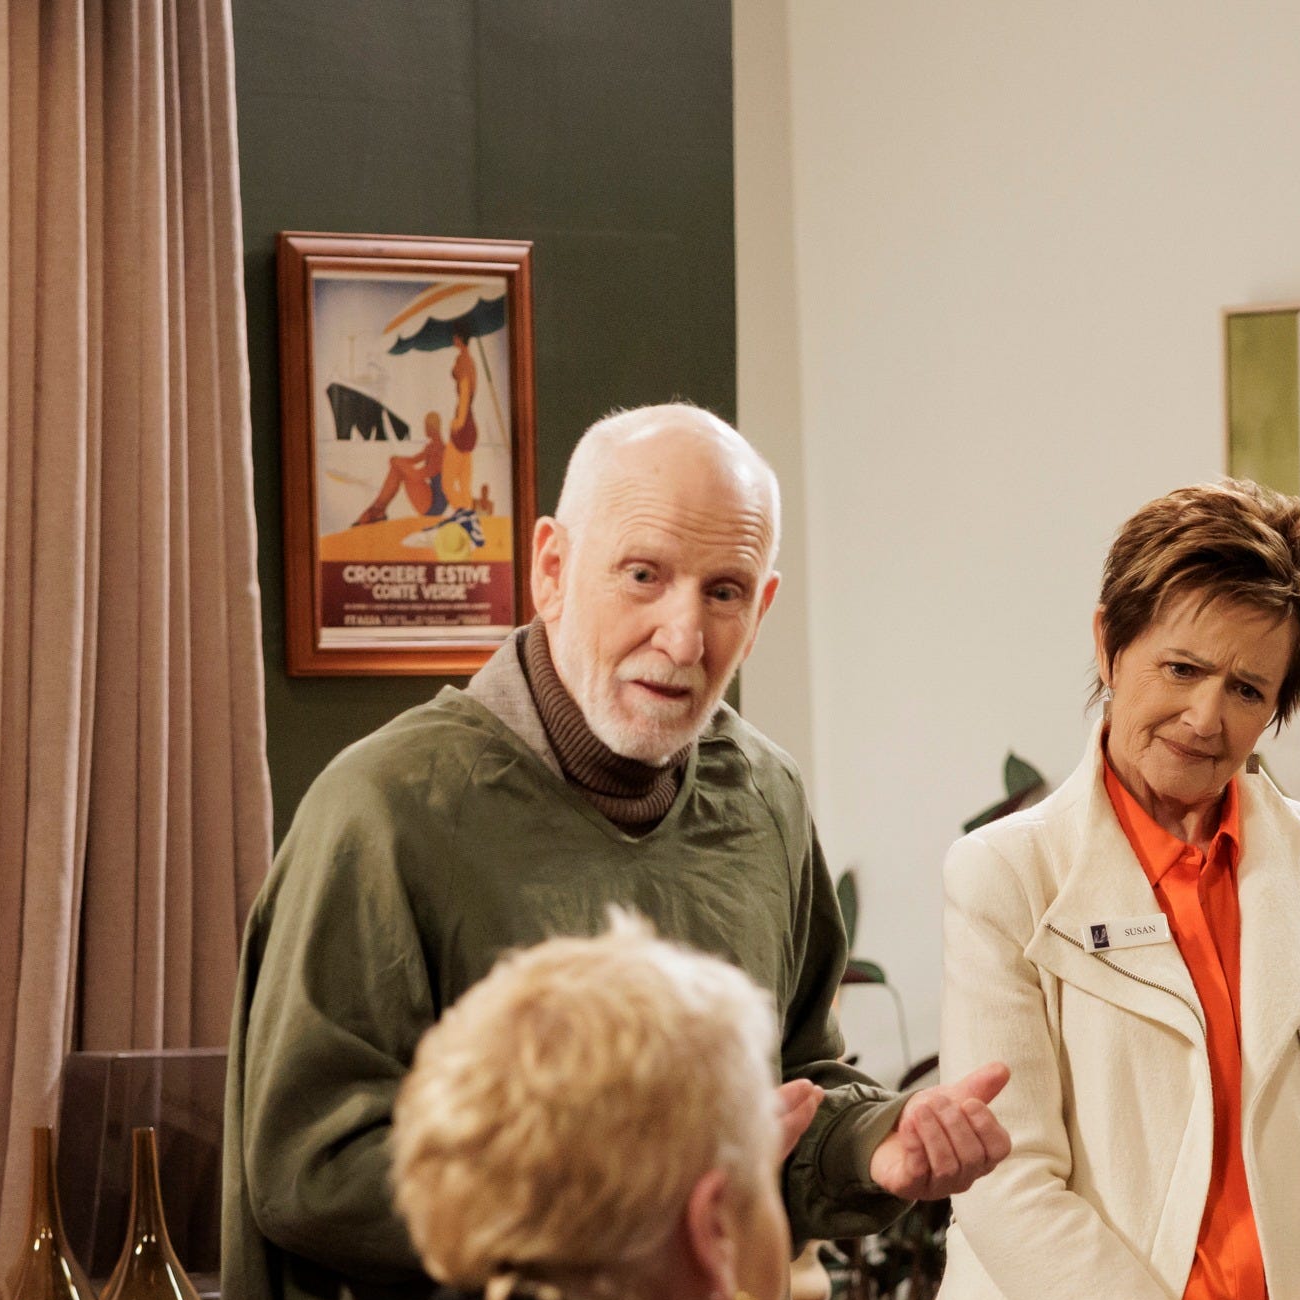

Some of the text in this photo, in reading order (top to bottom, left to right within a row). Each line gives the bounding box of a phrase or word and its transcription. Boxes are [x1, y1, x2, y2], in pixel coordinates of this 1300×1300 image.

[343, 565, 491, 584] CROCIERE ESTIVE
[372, 584, 418, 600] CONTE
[1124, 925, 1156, 936] SUSAN
